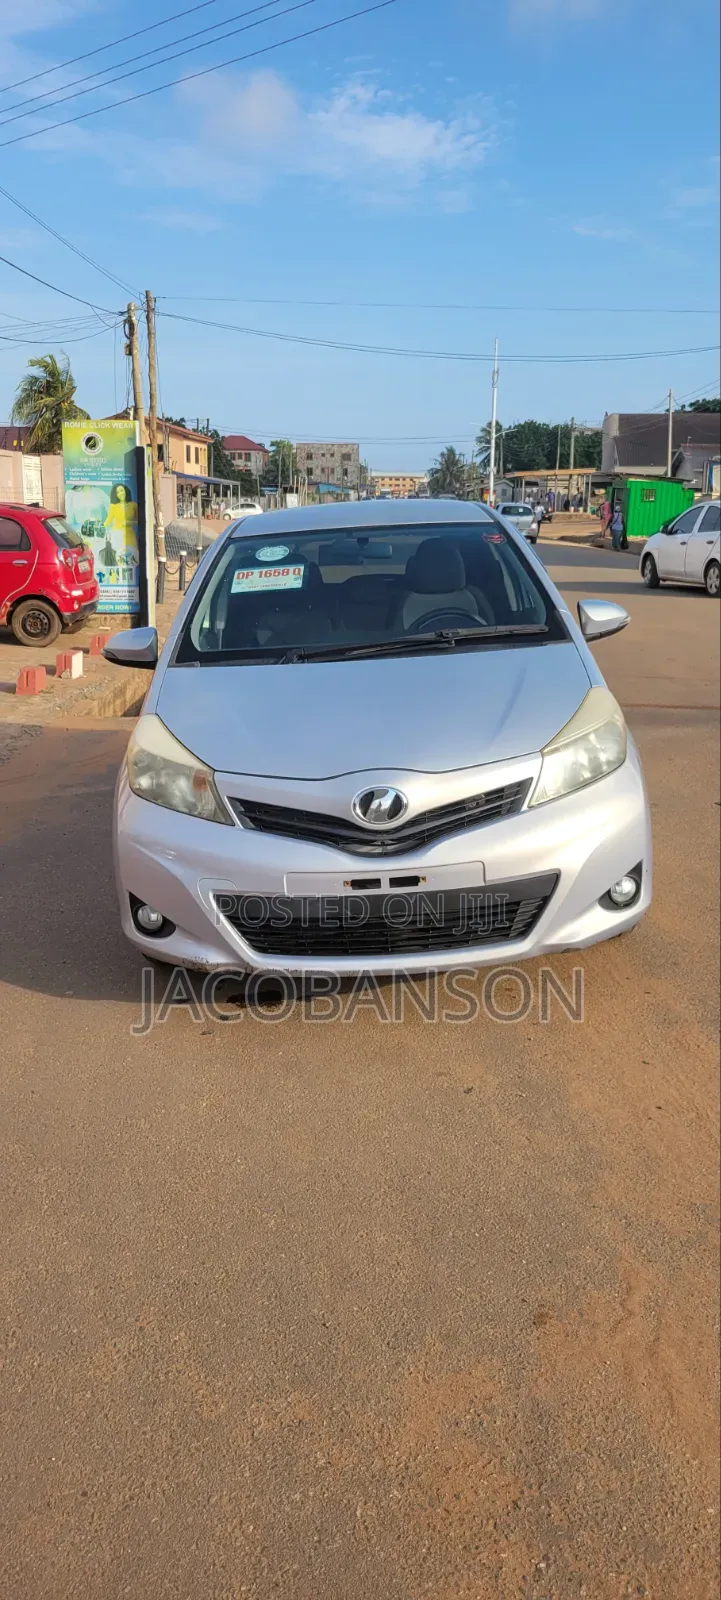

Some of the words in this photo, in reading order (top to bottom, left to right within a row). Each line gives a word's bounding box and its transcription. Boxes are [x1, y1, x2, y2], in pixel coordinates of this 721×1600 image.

[236, 571, 254, 580] DP
[258, 568, 290, 579] 1658
[293, 567, 302, 577] Q
